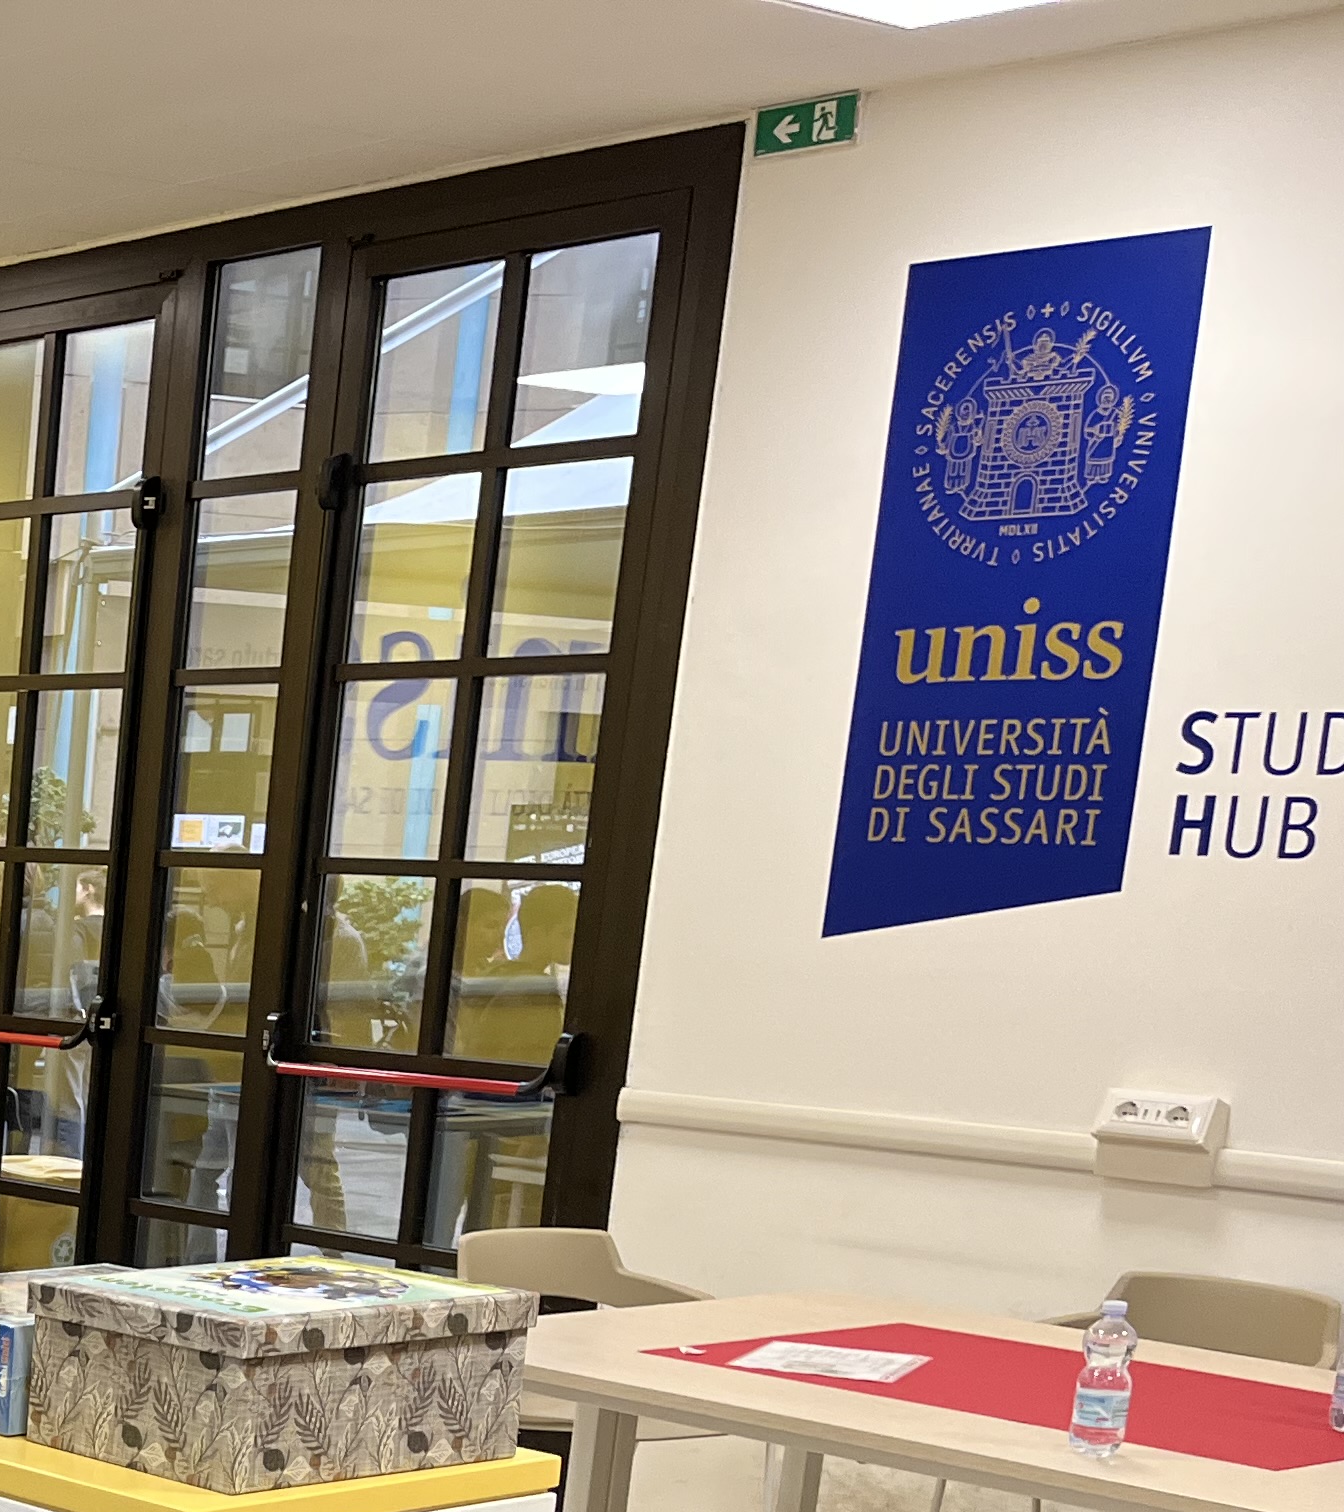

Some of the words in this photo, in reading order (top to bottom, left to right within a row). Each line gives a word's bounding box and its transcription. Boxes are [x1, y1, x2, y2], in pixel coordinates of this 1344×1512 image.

[913, 308, 1018, 436] SACERENSIS
[1076, 300, 1155, 385] SIGILLVM
[1032, 410, 1156, 564] VNIVERSITATIS
[998, 522, 1039, 537] MDLXII
[894, 596, 1125, 685] uniss
[879, 707, 1112, 757] UNIVERSITÀ
[872, 763, 977, 802] DEGLI
[989, 762, 1109, 802] STUDI
[867, 808, 907, 844] DI
[925, 806, 1103, 847] SASSARI
[1169, 794, 1320, 861] HUB
